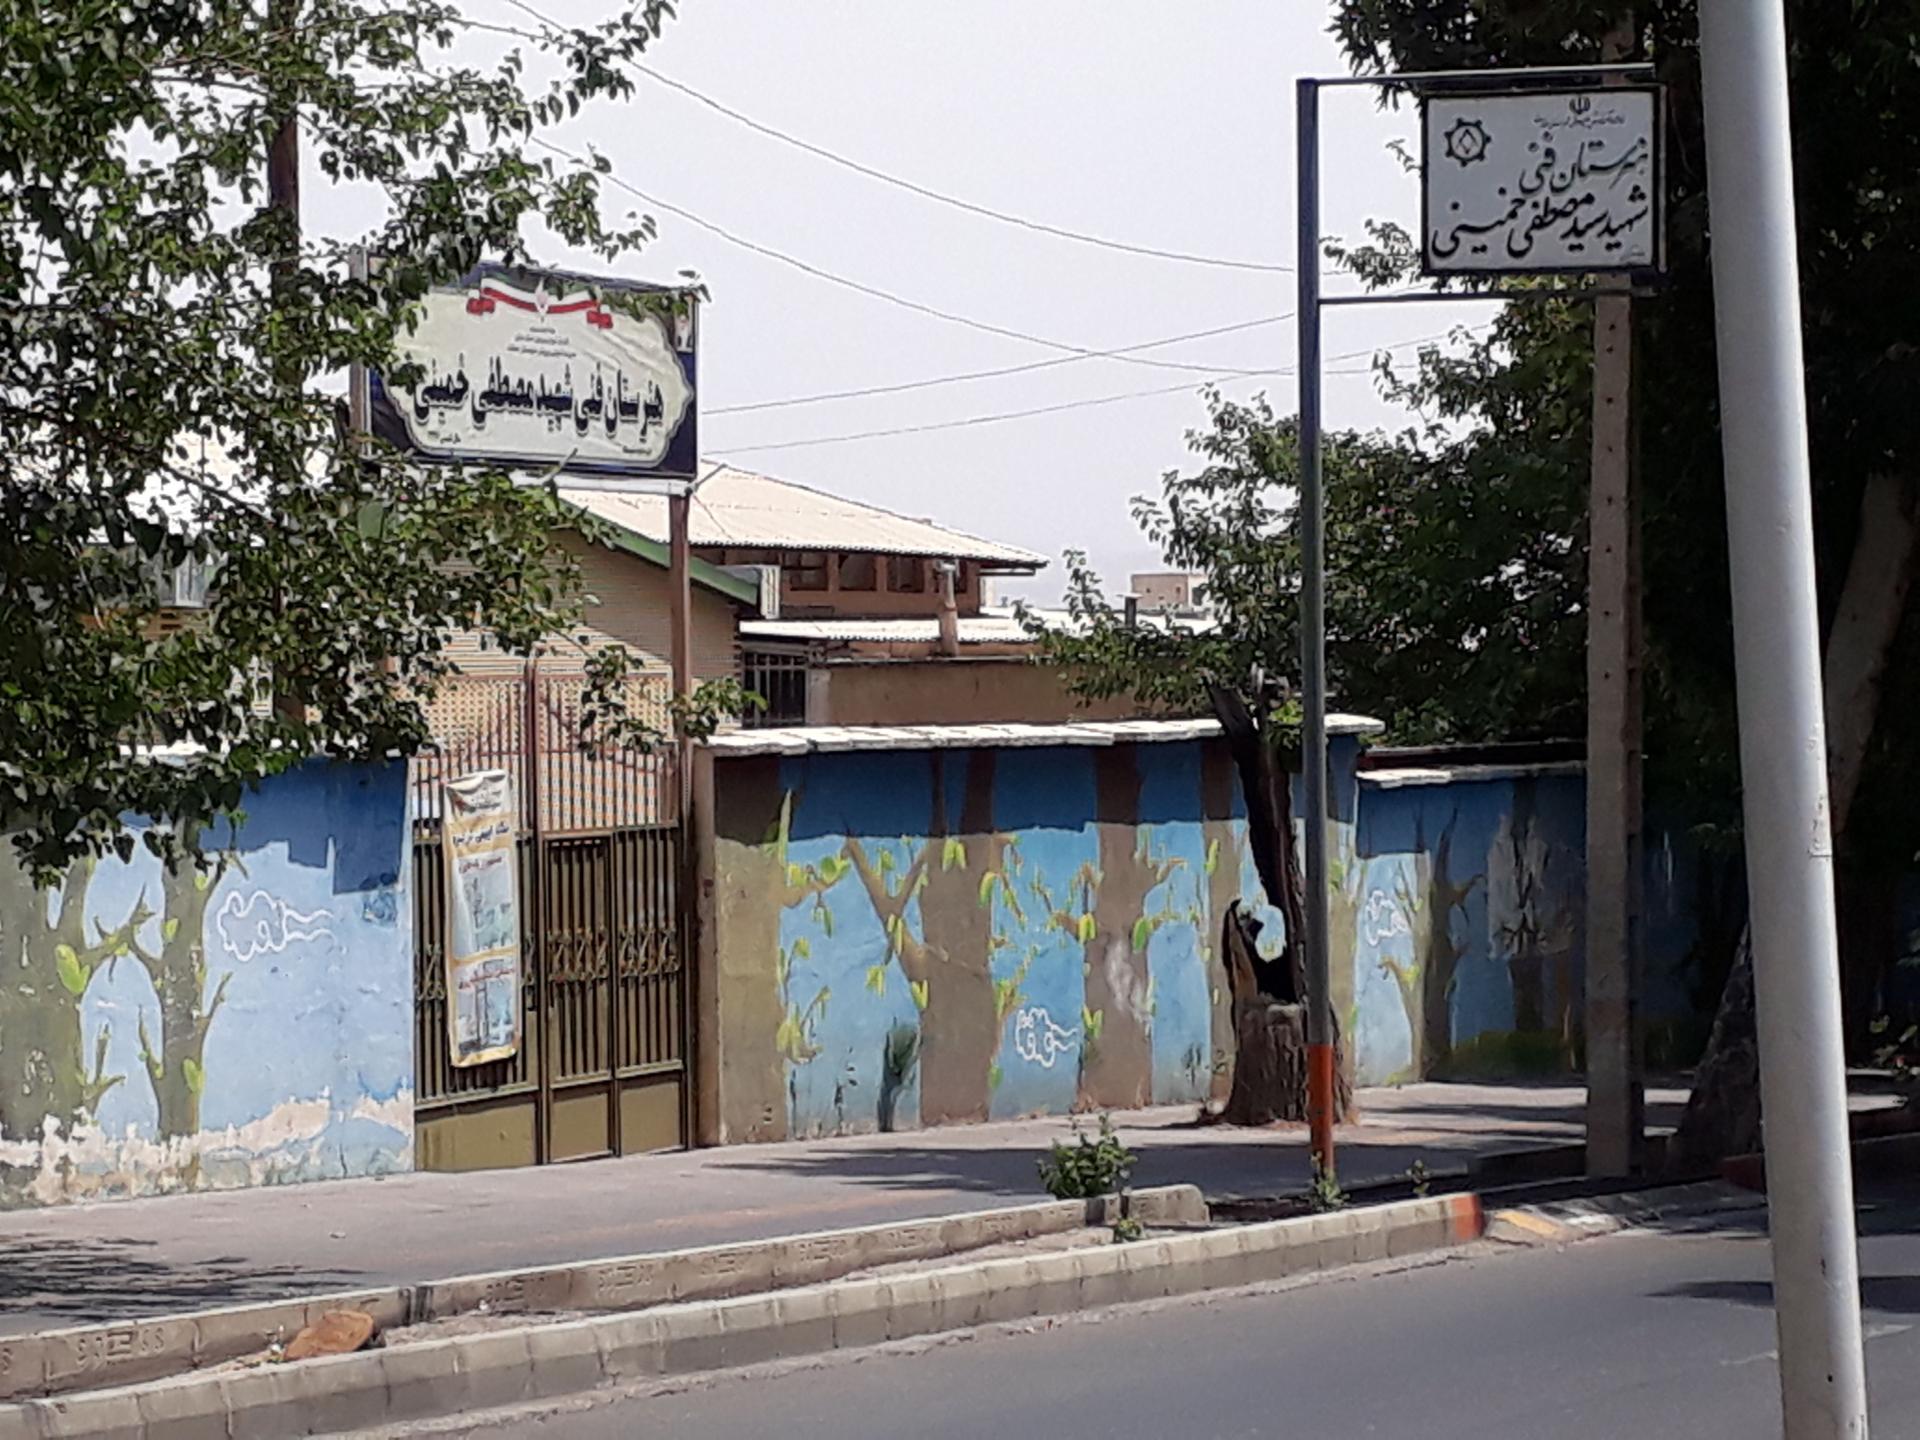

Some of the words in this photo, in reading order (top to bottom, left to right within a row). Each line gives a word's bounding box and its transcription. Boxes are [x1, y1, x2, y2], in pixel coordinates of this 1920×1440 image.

[1519, 131, 1556, 194] فنی
[1549, 136, 1649, 193] هنرستان
[1431, 187, 1526, 258] خمینی
[1507, 193, 1595, 258] مصطفی
[1560, 210, 1609, 251] سید
[1597, 184, 1649, 250] شهید
[413, 352, 470, 425] خمینی
[471, 355, 534, 428] مصطفی
[536, 364, 573, 431] شهید
[574, 361, 603, 432] فنی
[604, 369, 664, 442] هنرستان
